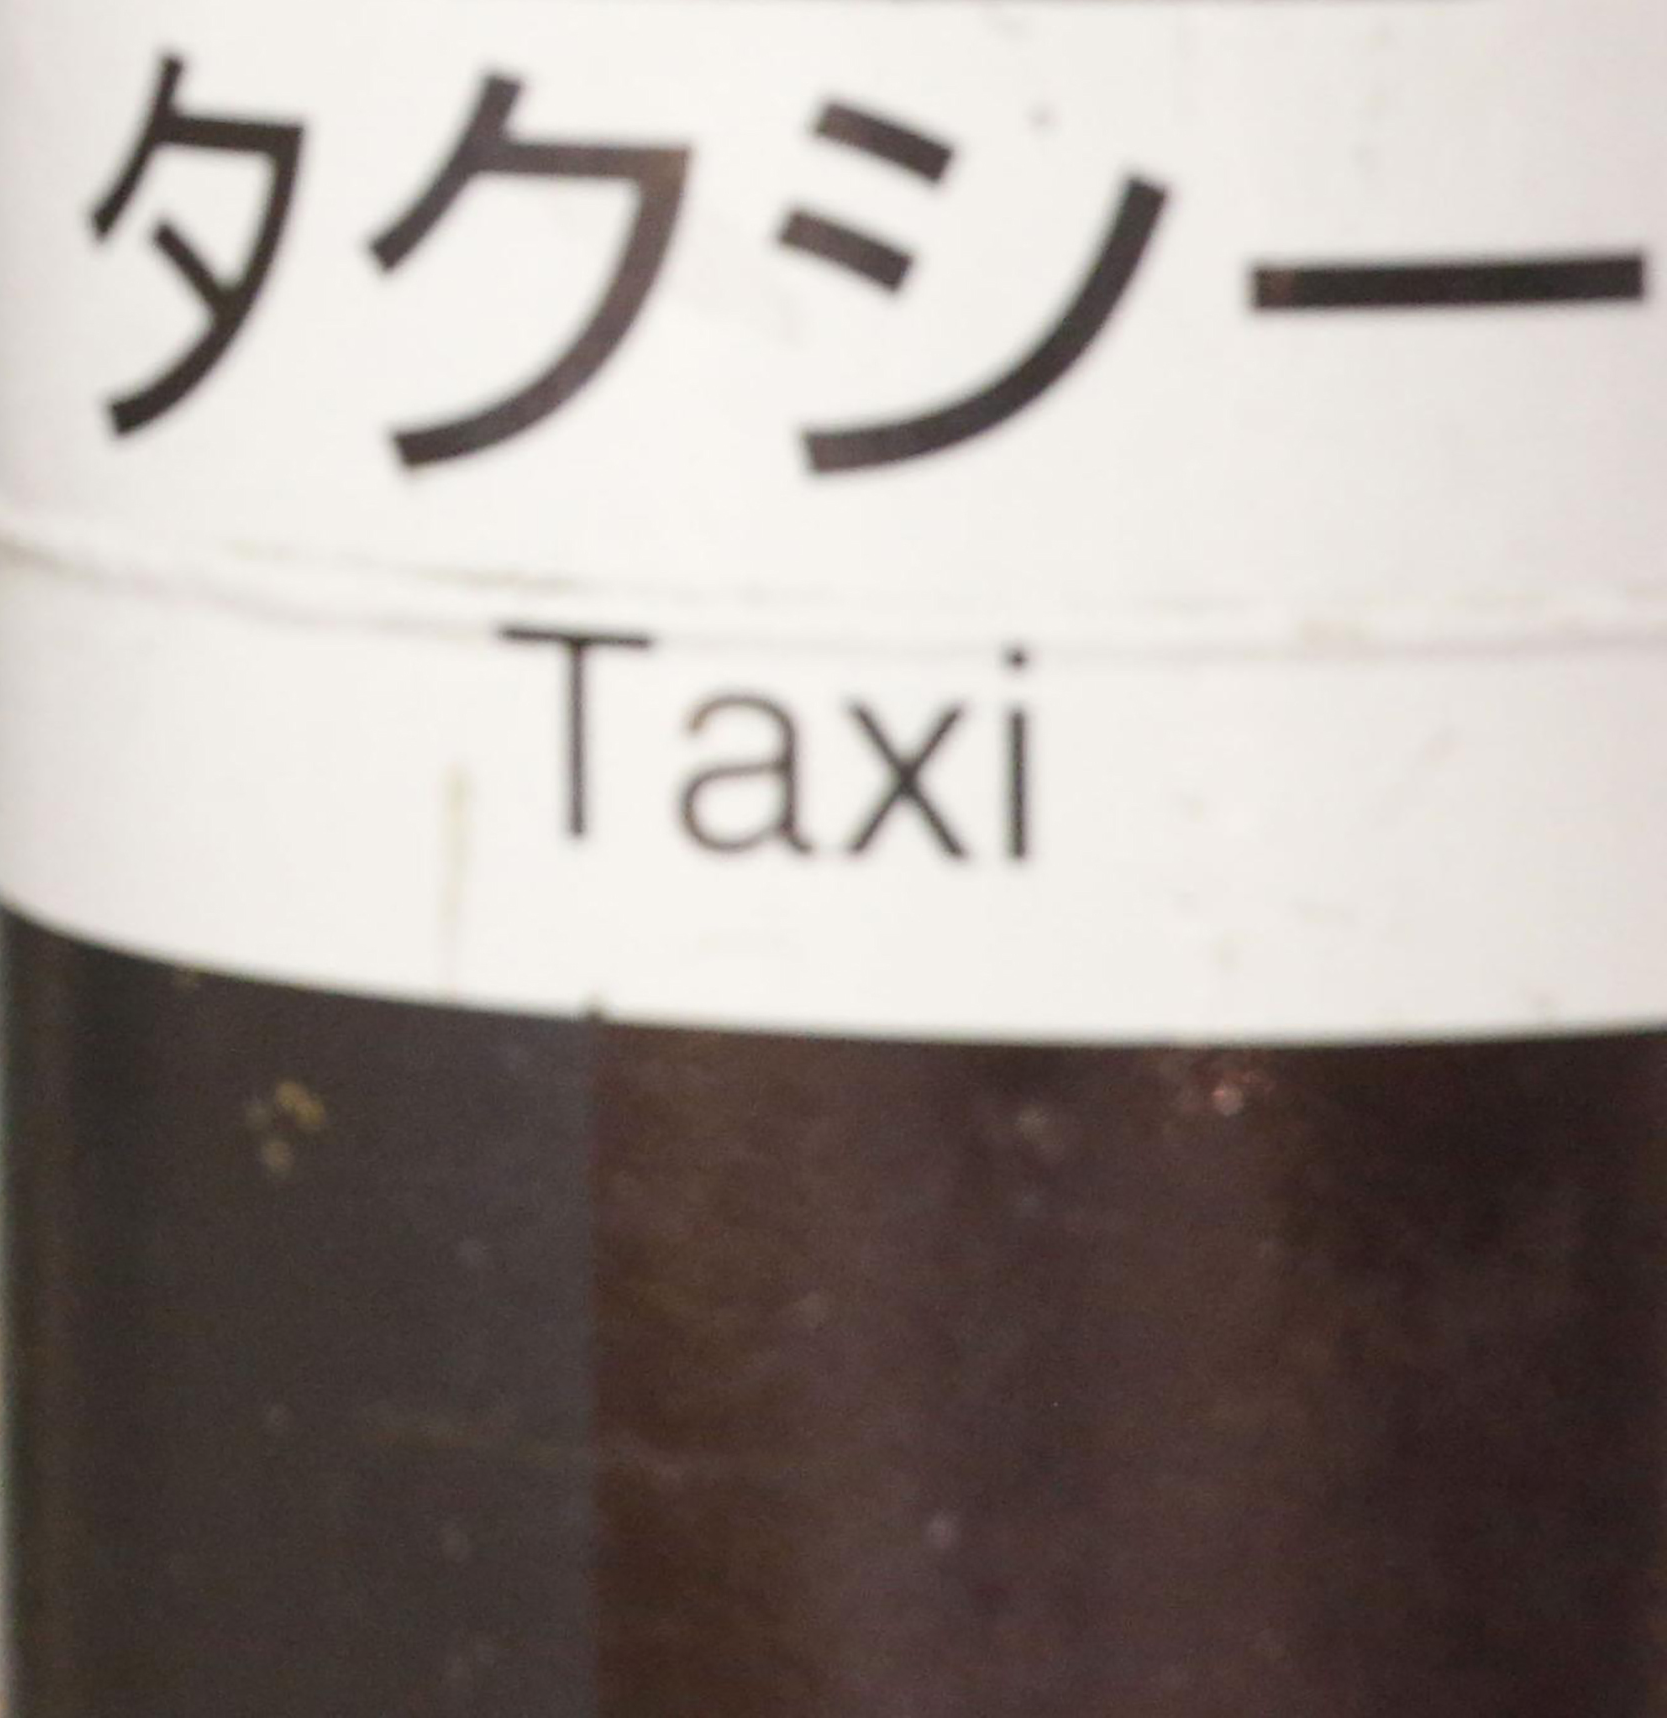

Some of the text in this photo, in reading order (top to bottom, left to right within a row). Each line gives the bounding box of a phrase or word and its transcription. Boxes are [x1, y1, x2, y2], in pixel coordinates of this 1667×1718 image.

[87, 50, 1648, 476] タクシー
[498, 620, 1035, 866] Taxi
